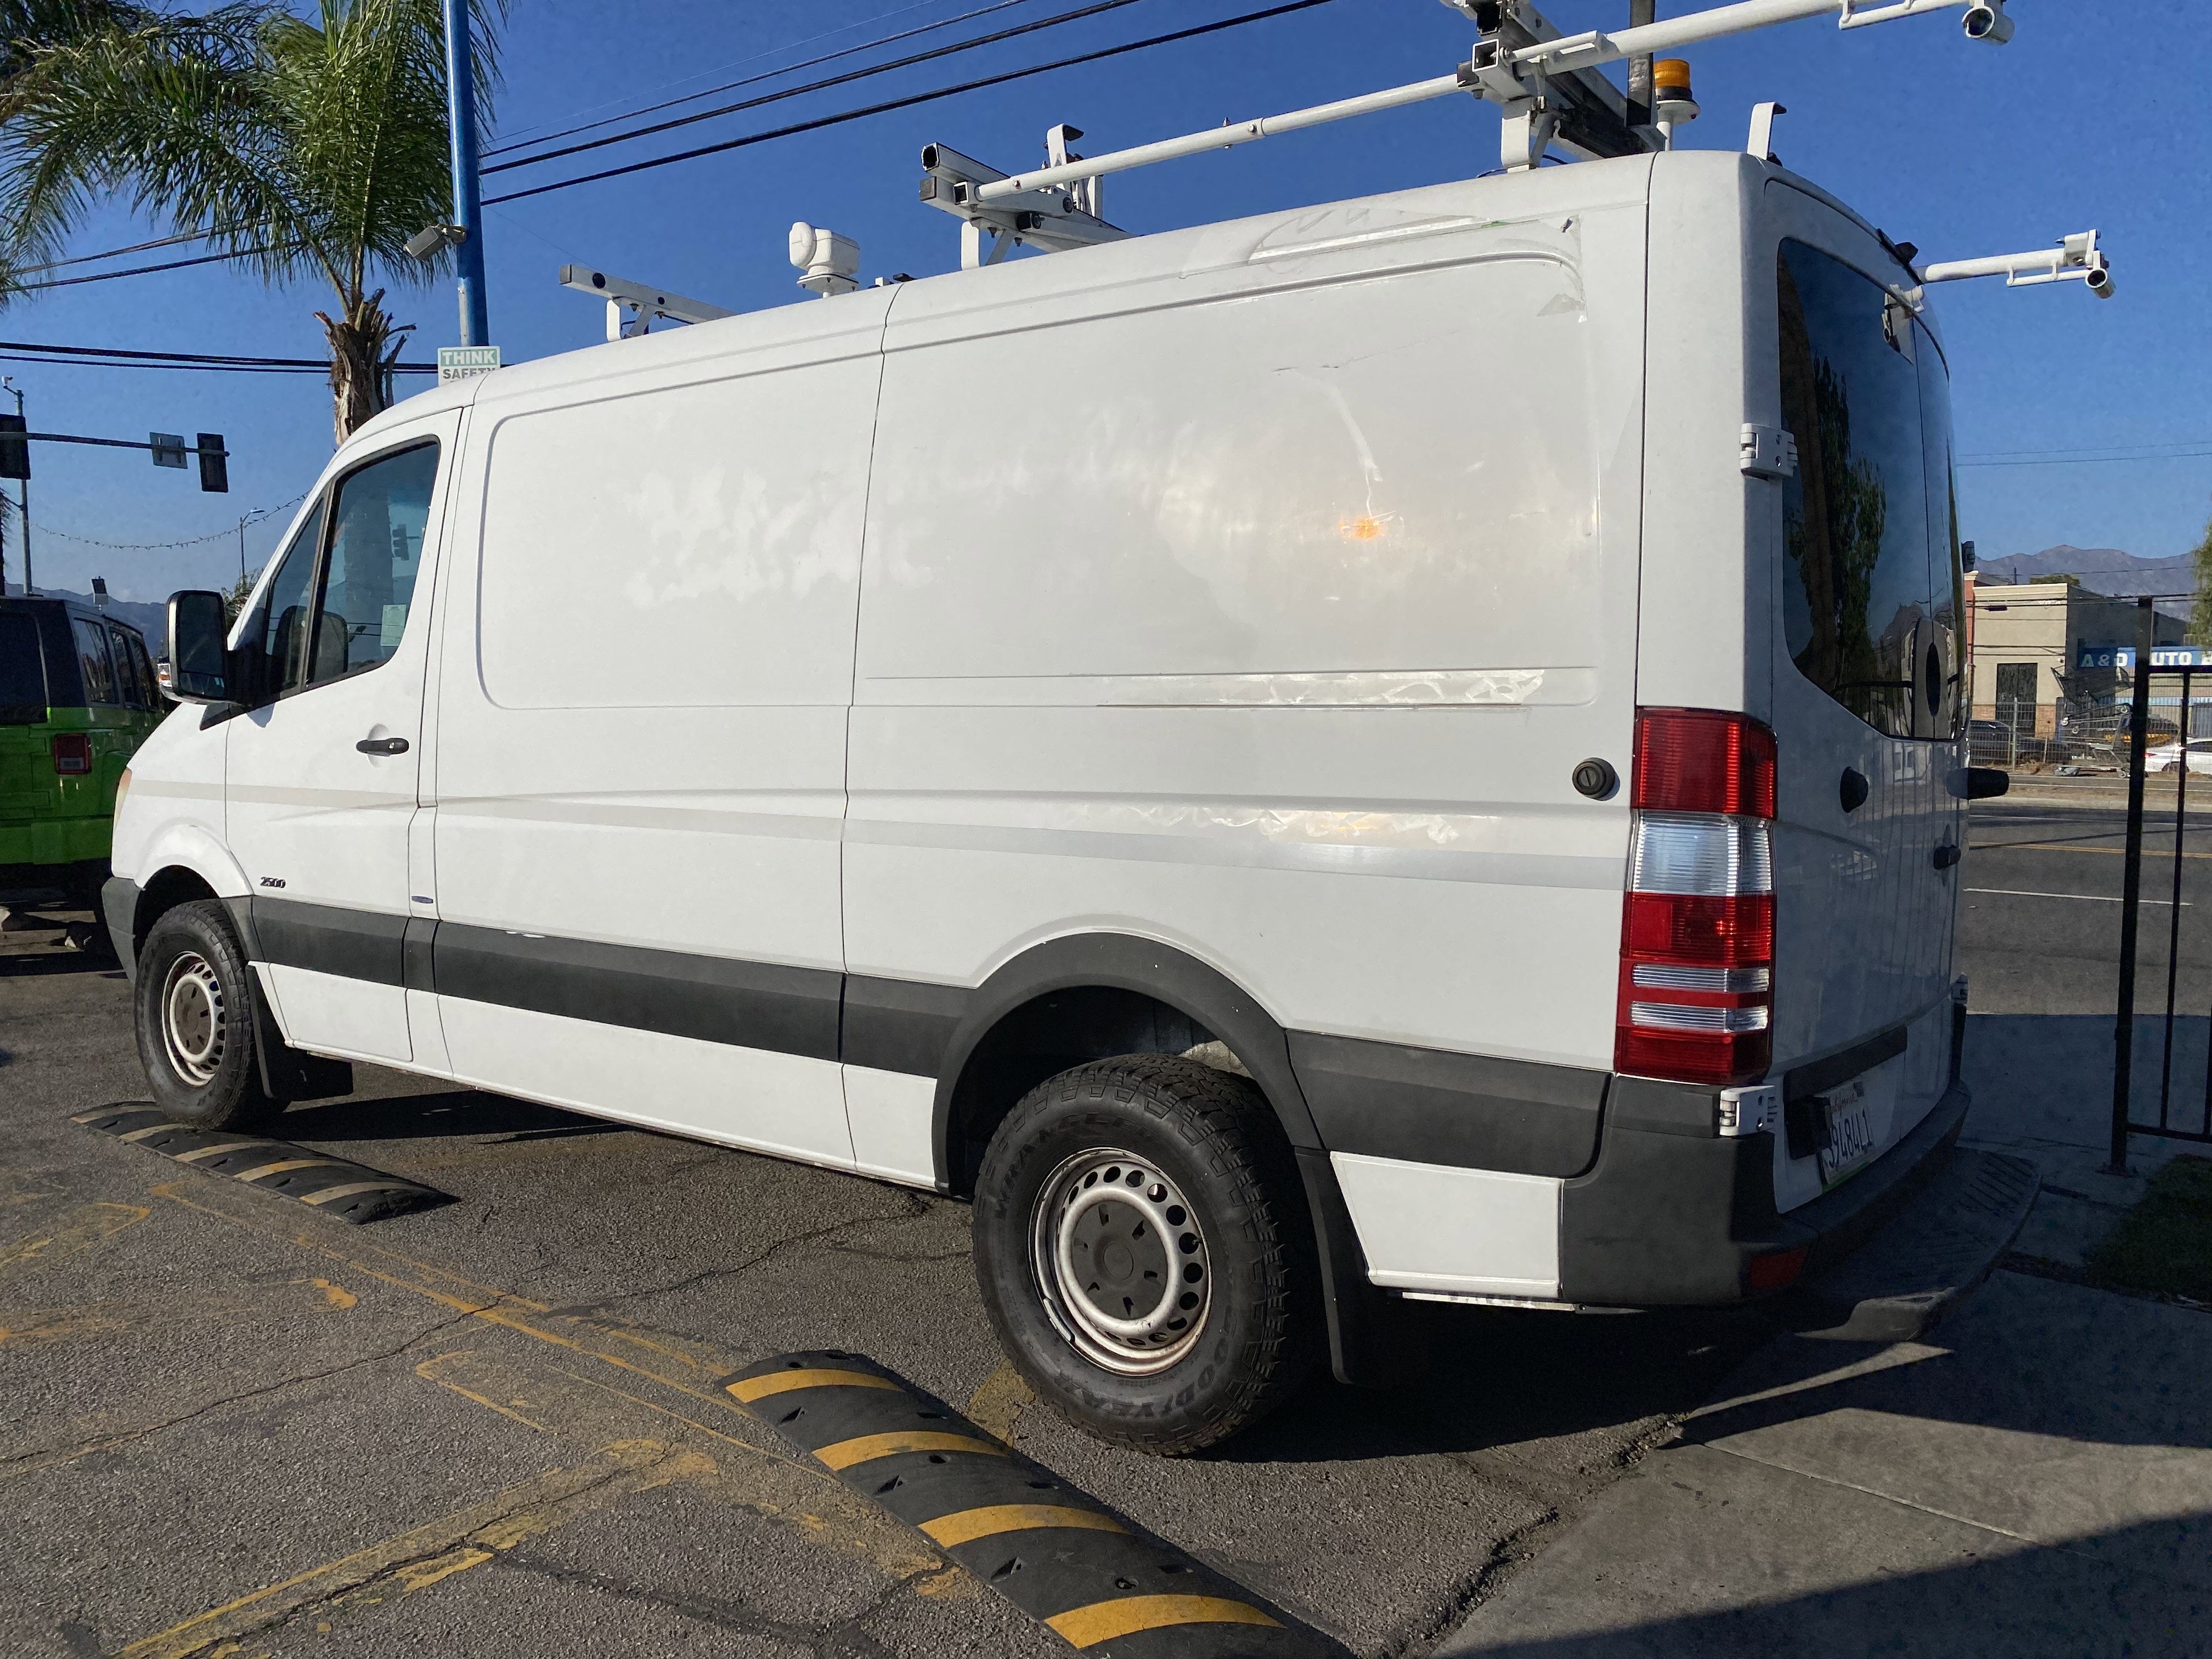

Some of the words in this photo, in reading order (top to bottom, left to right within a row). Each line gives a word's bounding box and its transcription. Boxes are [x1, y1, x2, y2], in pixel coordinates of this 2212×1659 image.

[442, 350, 495, 365] THINK
[2081, 653, 2095, 667] A
[2097, 654, 2110, 667] &
[2113, 652, 2128, 667] D
[2151, 652, 2192, 666] UTO
[260, 877, 286, 888] 2500
